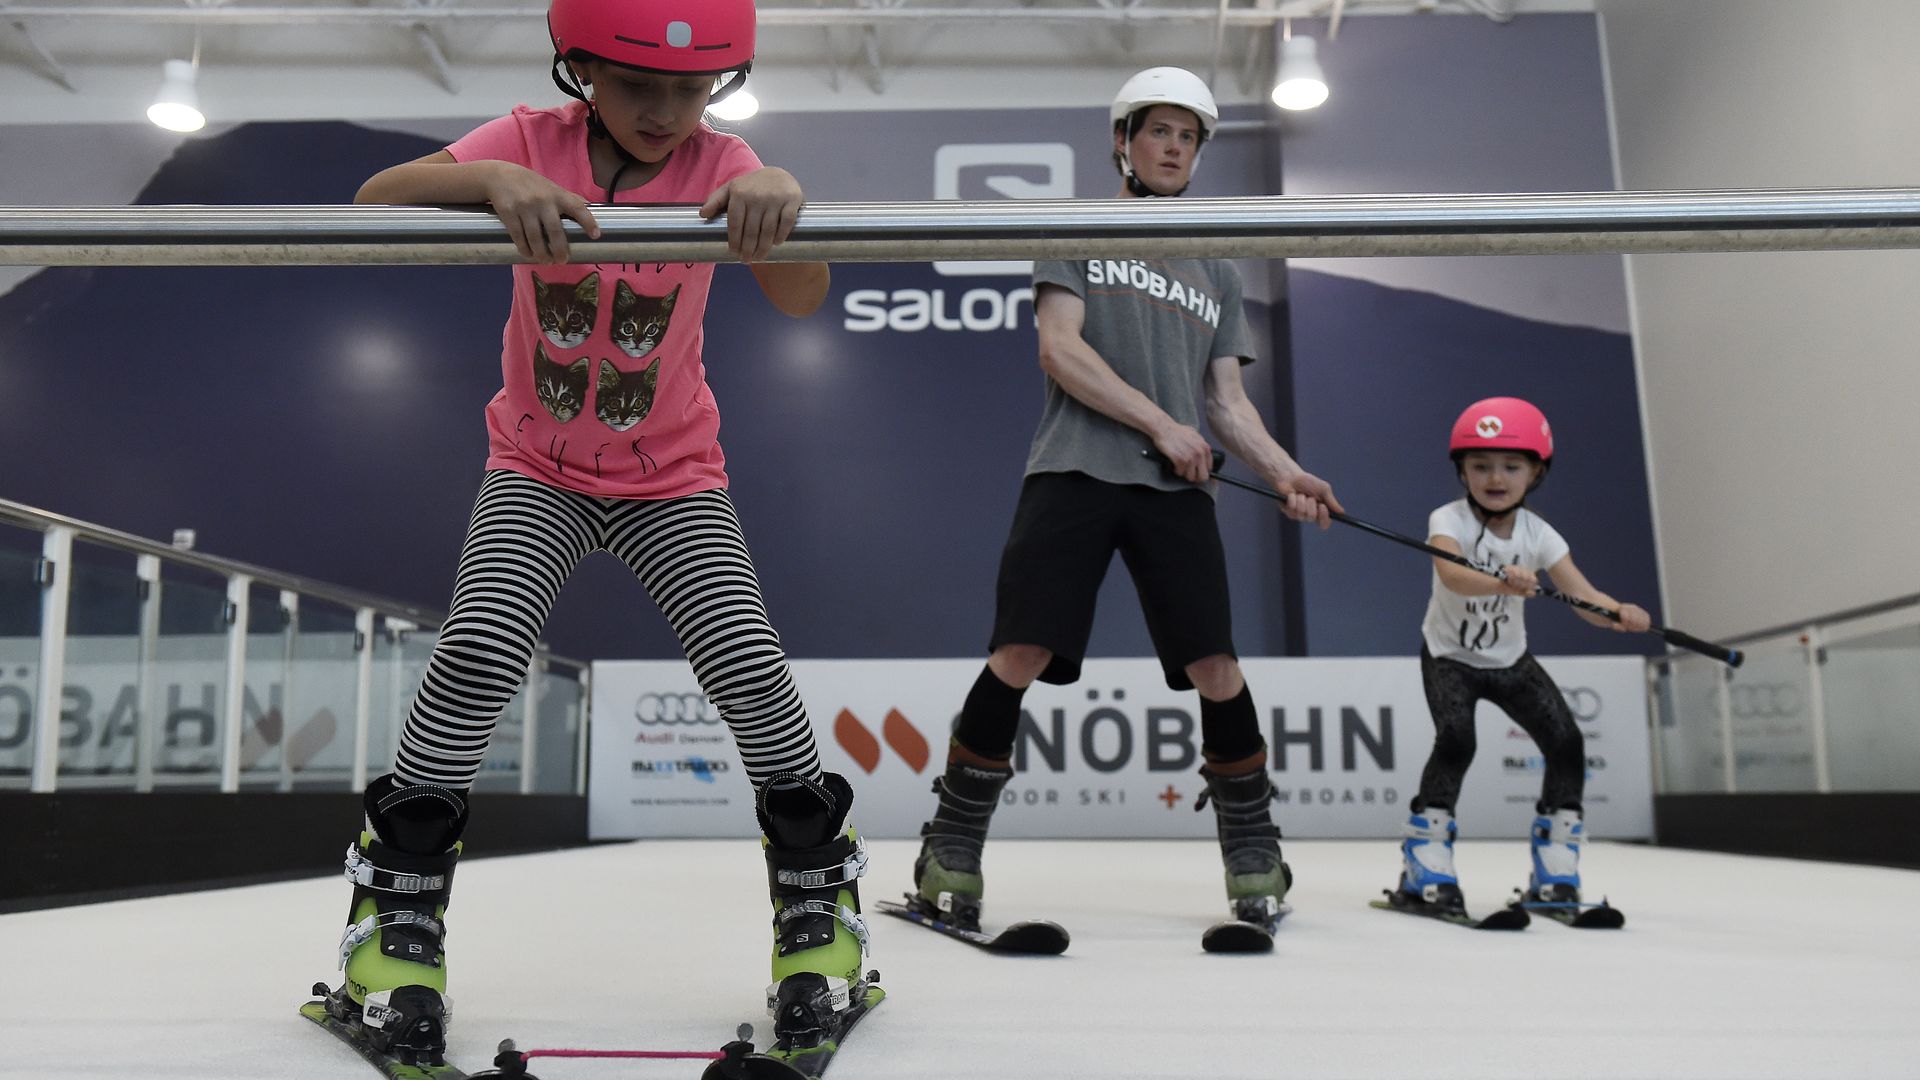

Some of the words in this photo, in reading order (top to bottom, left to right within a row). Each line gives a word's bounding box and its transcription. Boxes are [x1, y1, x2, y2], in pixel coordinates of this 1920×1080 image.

[1087, 260, 1221, 329] SNÖBAHN
[951, 688, 1396, 773] NÖBHN
[1002, 789, 1059, 805] OOR
[1080, 789, 1126, 805] SKI
[1277, 788, 1398, 805] WBOARD
